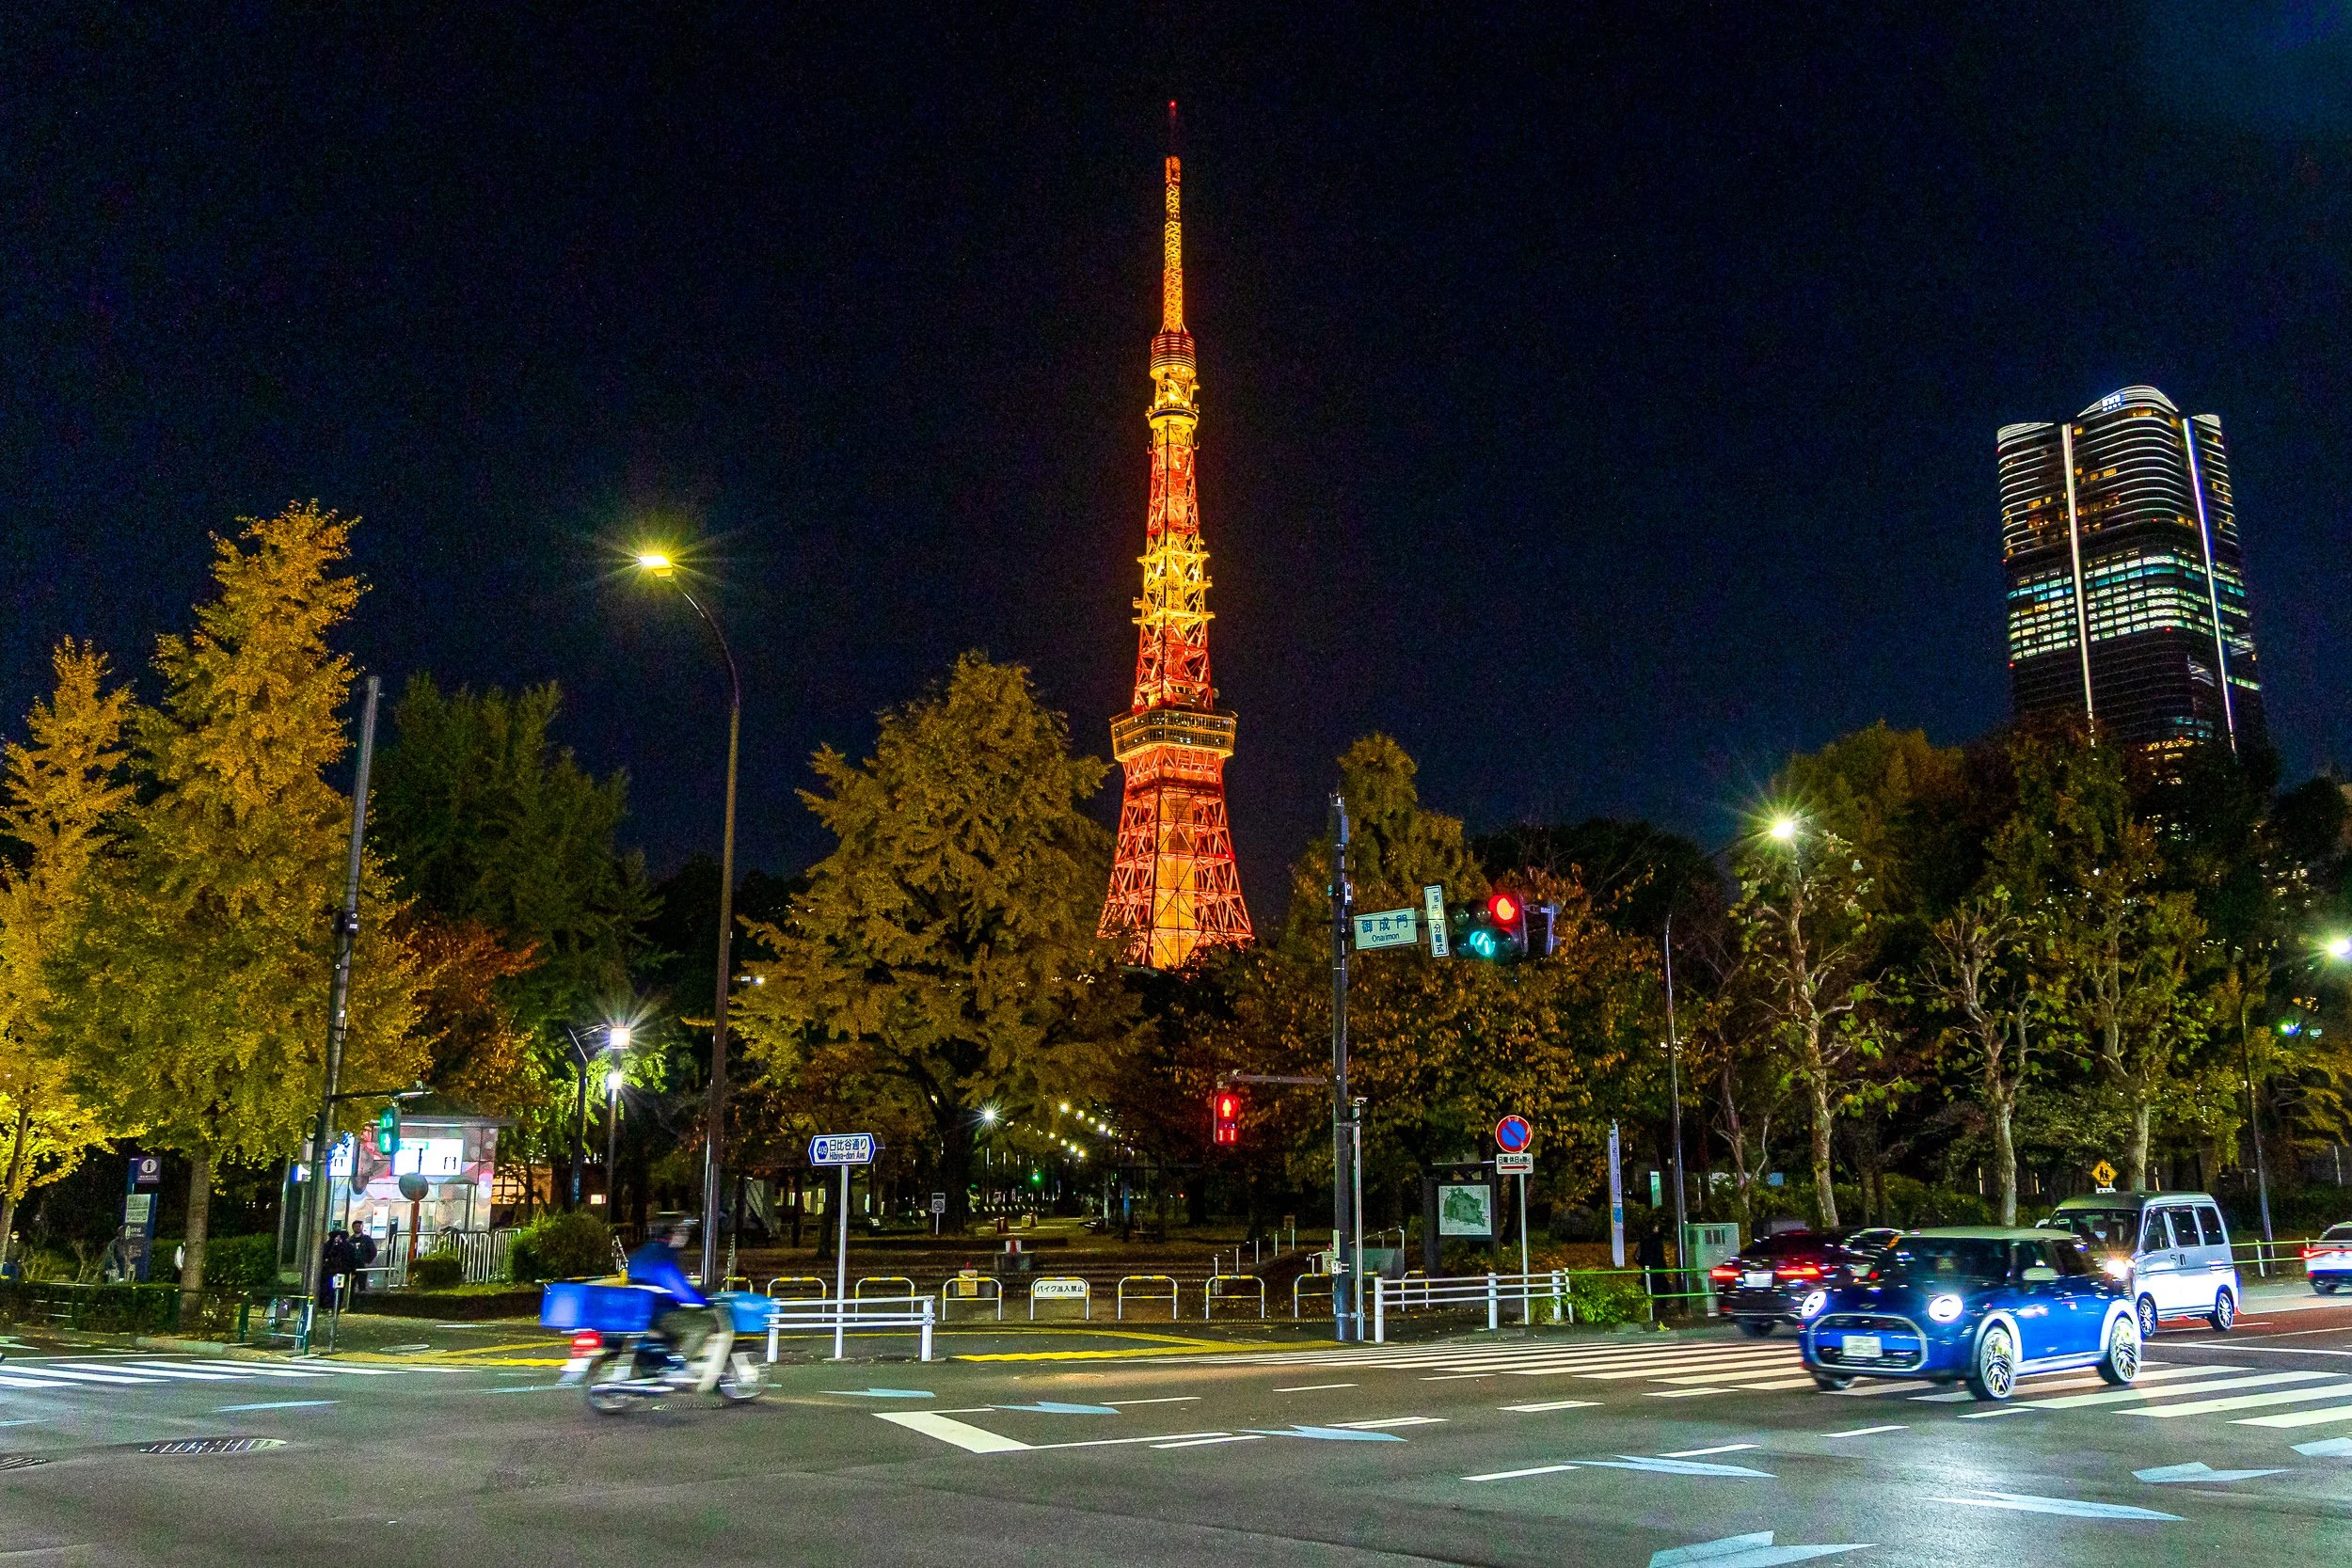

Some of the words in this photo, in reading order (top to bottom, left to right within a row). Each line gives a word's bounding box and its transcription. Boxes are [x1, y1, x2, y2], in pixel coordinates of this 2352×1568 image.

[1361, 914, 1408, 933] 御成門
[1372, 932, 1400, 942] Onarimon
[829, 1139, 866, 1150] 日比谷通り
